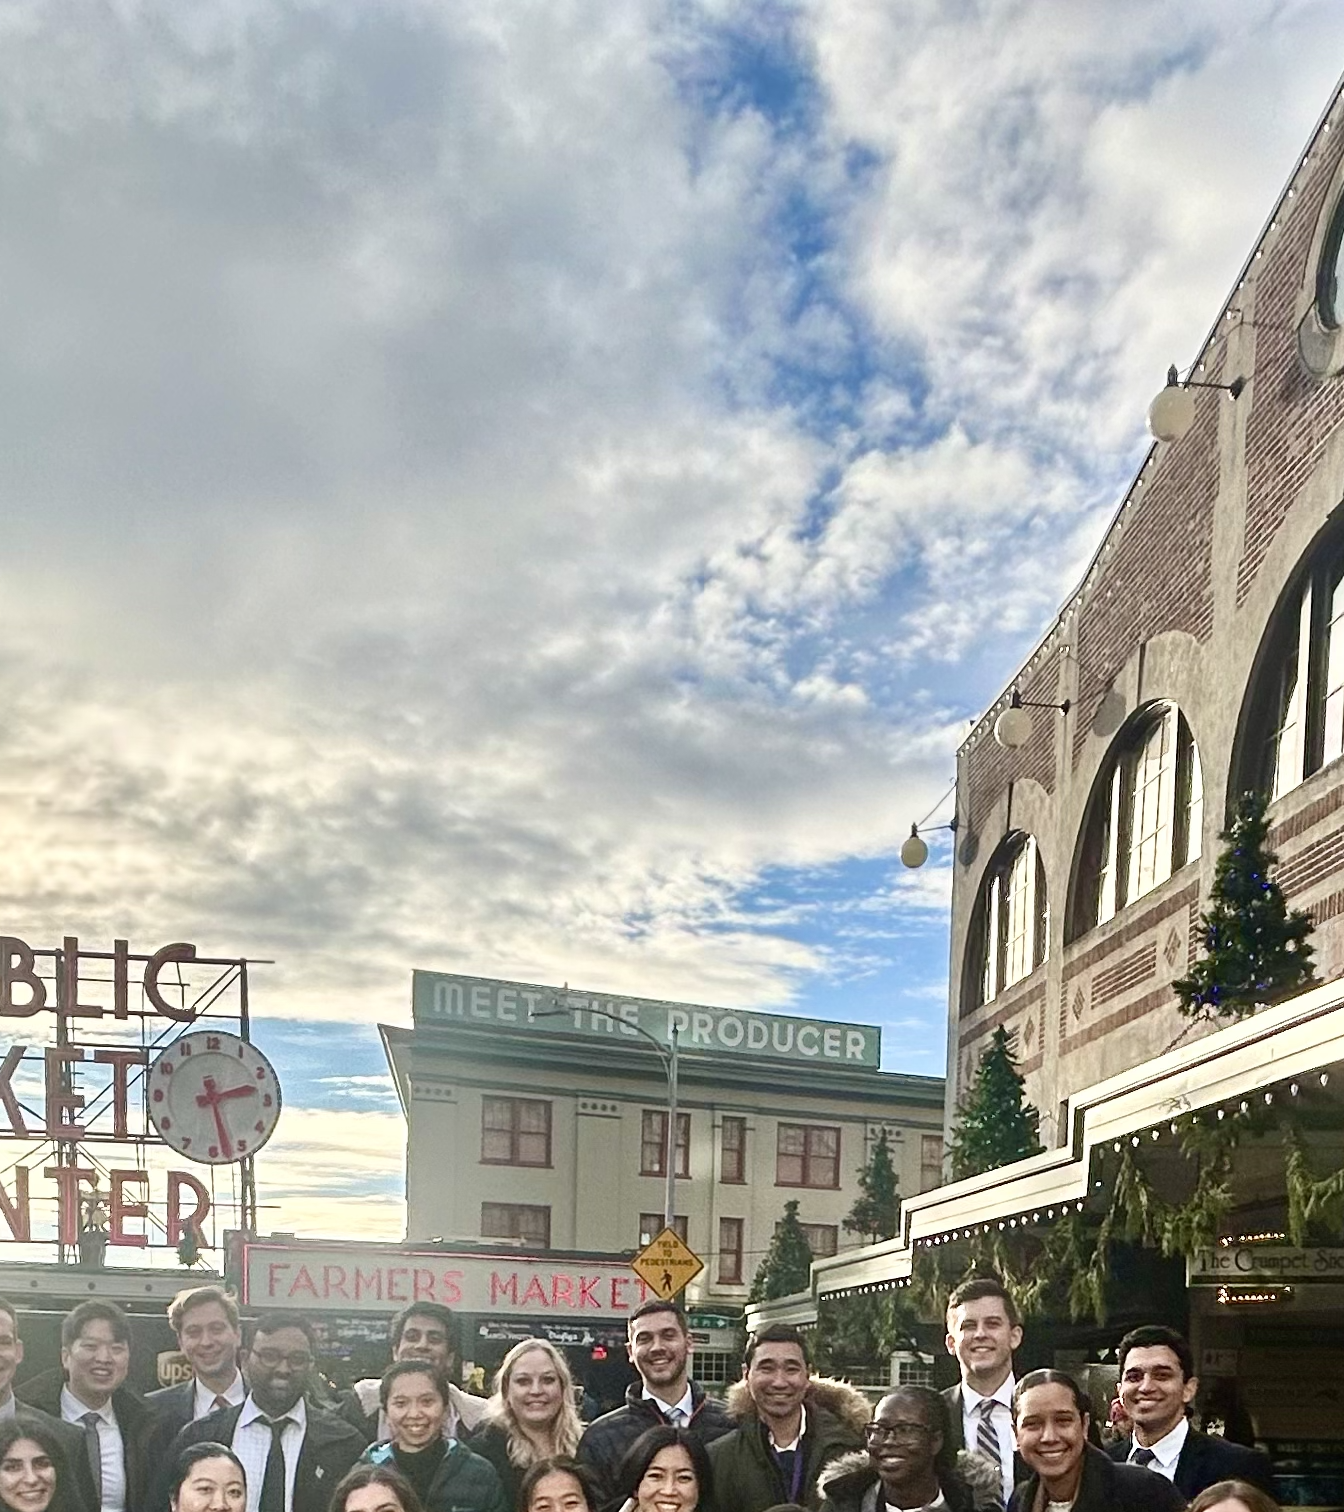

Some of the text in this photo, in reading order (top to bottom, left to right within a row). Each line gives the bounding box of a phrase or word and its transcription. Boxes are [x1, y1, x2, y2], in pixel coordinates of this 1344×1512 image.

[432, 979, 867, 1061] MEET THE PRODUCER
[180, 1042, 192, 1057] 11
[206, 1036, 221, 1050] 12
[160, 1061, 174, 1076] 10
[255, 1066, 266, 1080] 2
[181, 1136, 192, 1150] 7
[237, 1139, 248, 1152] 5
[657, 1240, 679, 1249] YIELD
[663, 1250, 672, 1258] TO
[639, 1258, 694, 1267] PEDESTRIANS
[1198, 1249, 1231, 1273] The
[1234, 1248, 1308, 1276] Crumpet
[268, 1262, 649, 1311] FARMERS MARKET
[161, 1363, 193, 1383] ups
